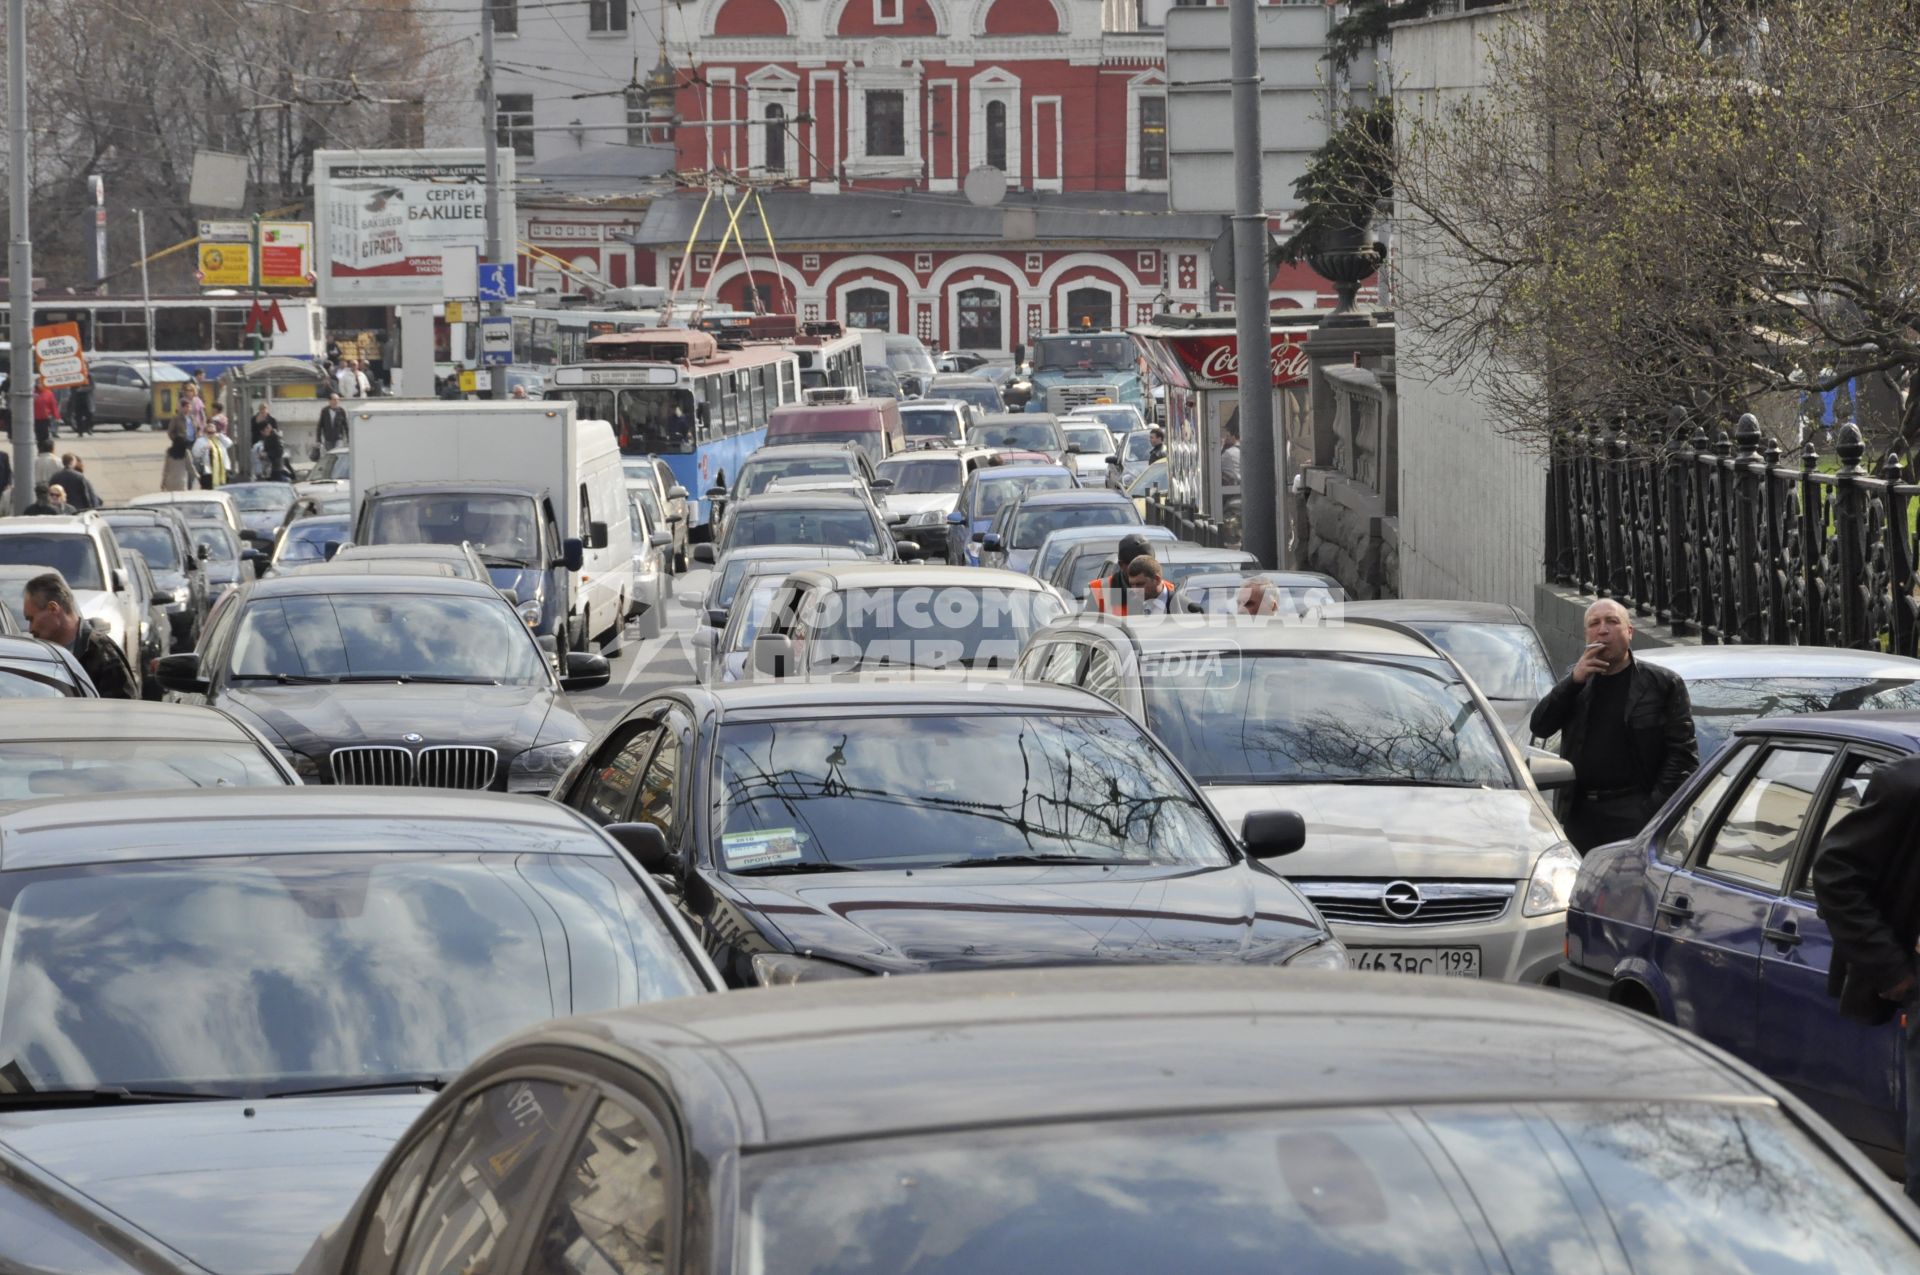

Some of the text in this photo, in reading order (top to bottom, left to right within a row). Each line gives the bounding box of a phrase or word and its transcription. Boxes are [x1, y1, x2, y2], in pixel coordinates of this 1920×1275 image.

[426, 189, 475, 201] СЕРГЕЙ
[408, 204, 487, 220] БАКШЕЕ
[362, 237, 403, 258] СТРАСТЬ
[743, 855, 781, 864] ПРОПУСК
[1440, 951, 1473, 970] 199
